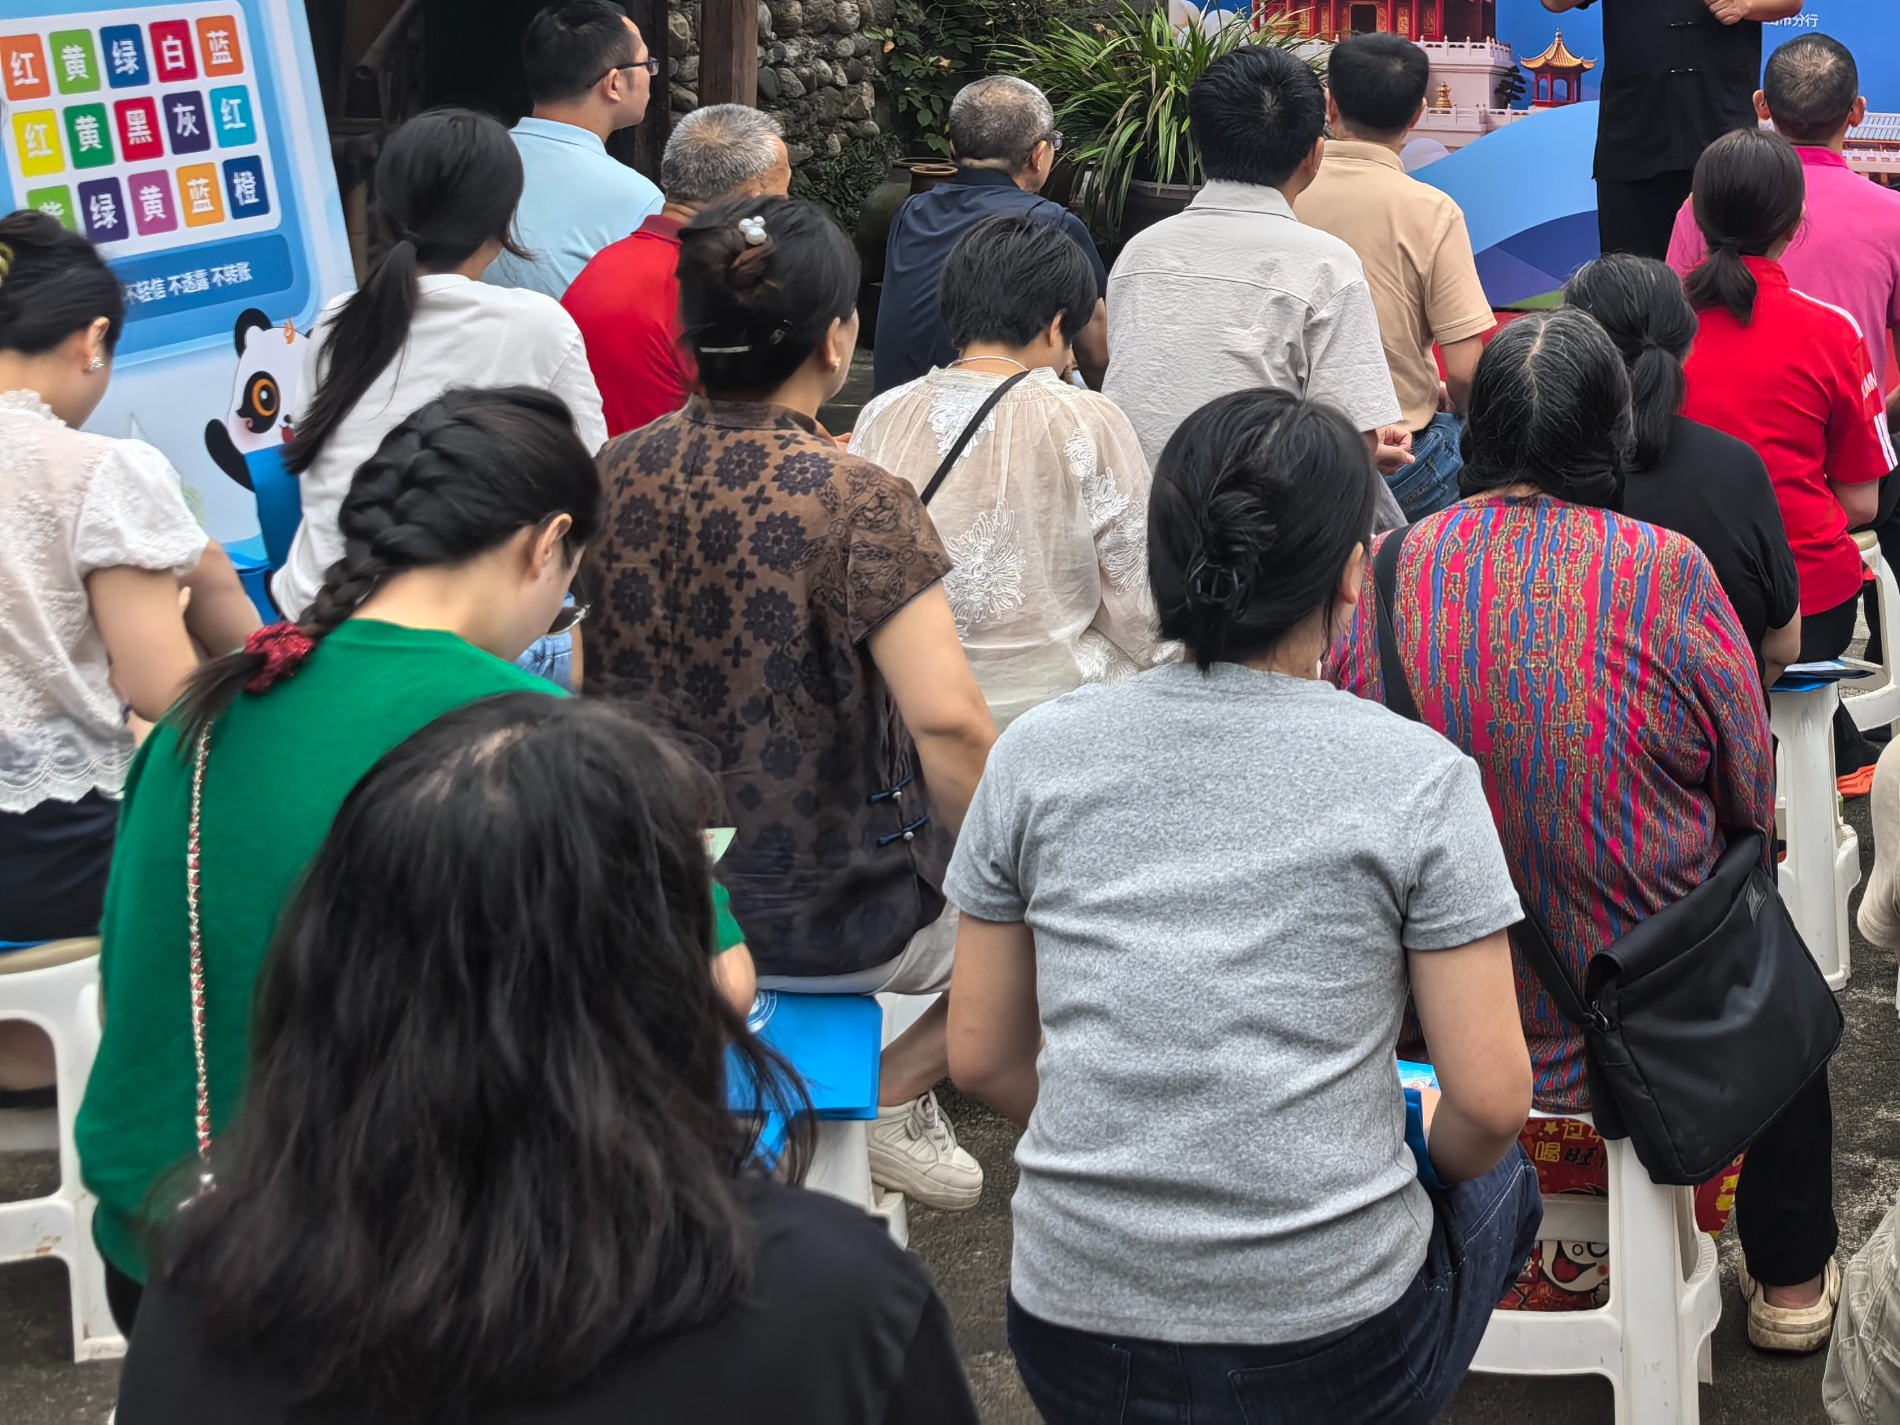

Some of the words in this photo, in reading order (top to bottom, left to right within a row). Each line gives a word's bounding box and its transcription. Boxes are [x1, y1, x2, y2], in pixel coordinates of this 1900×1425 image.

[10, 51, 40, 86] 红
[62, 44, 89, 81] 黄
[112, 39, 139, 75] 绿
[161, 35, 187, 71] 白
[207, 29, 233, 65] 蓝
[25, 122, 54, 158] 红
[74, 115, 103, 152] 黄
[125, 109, 152, 145] 黑
[173, 103, 200, 136] 灰
[221, 97, 246, 130] 红
[90, 193, 118, 230] 绿
[139, 185, 166, 222] 黄
[187, 178, 215, 214] 蓝
[233, 171, 260, 205] 橙
